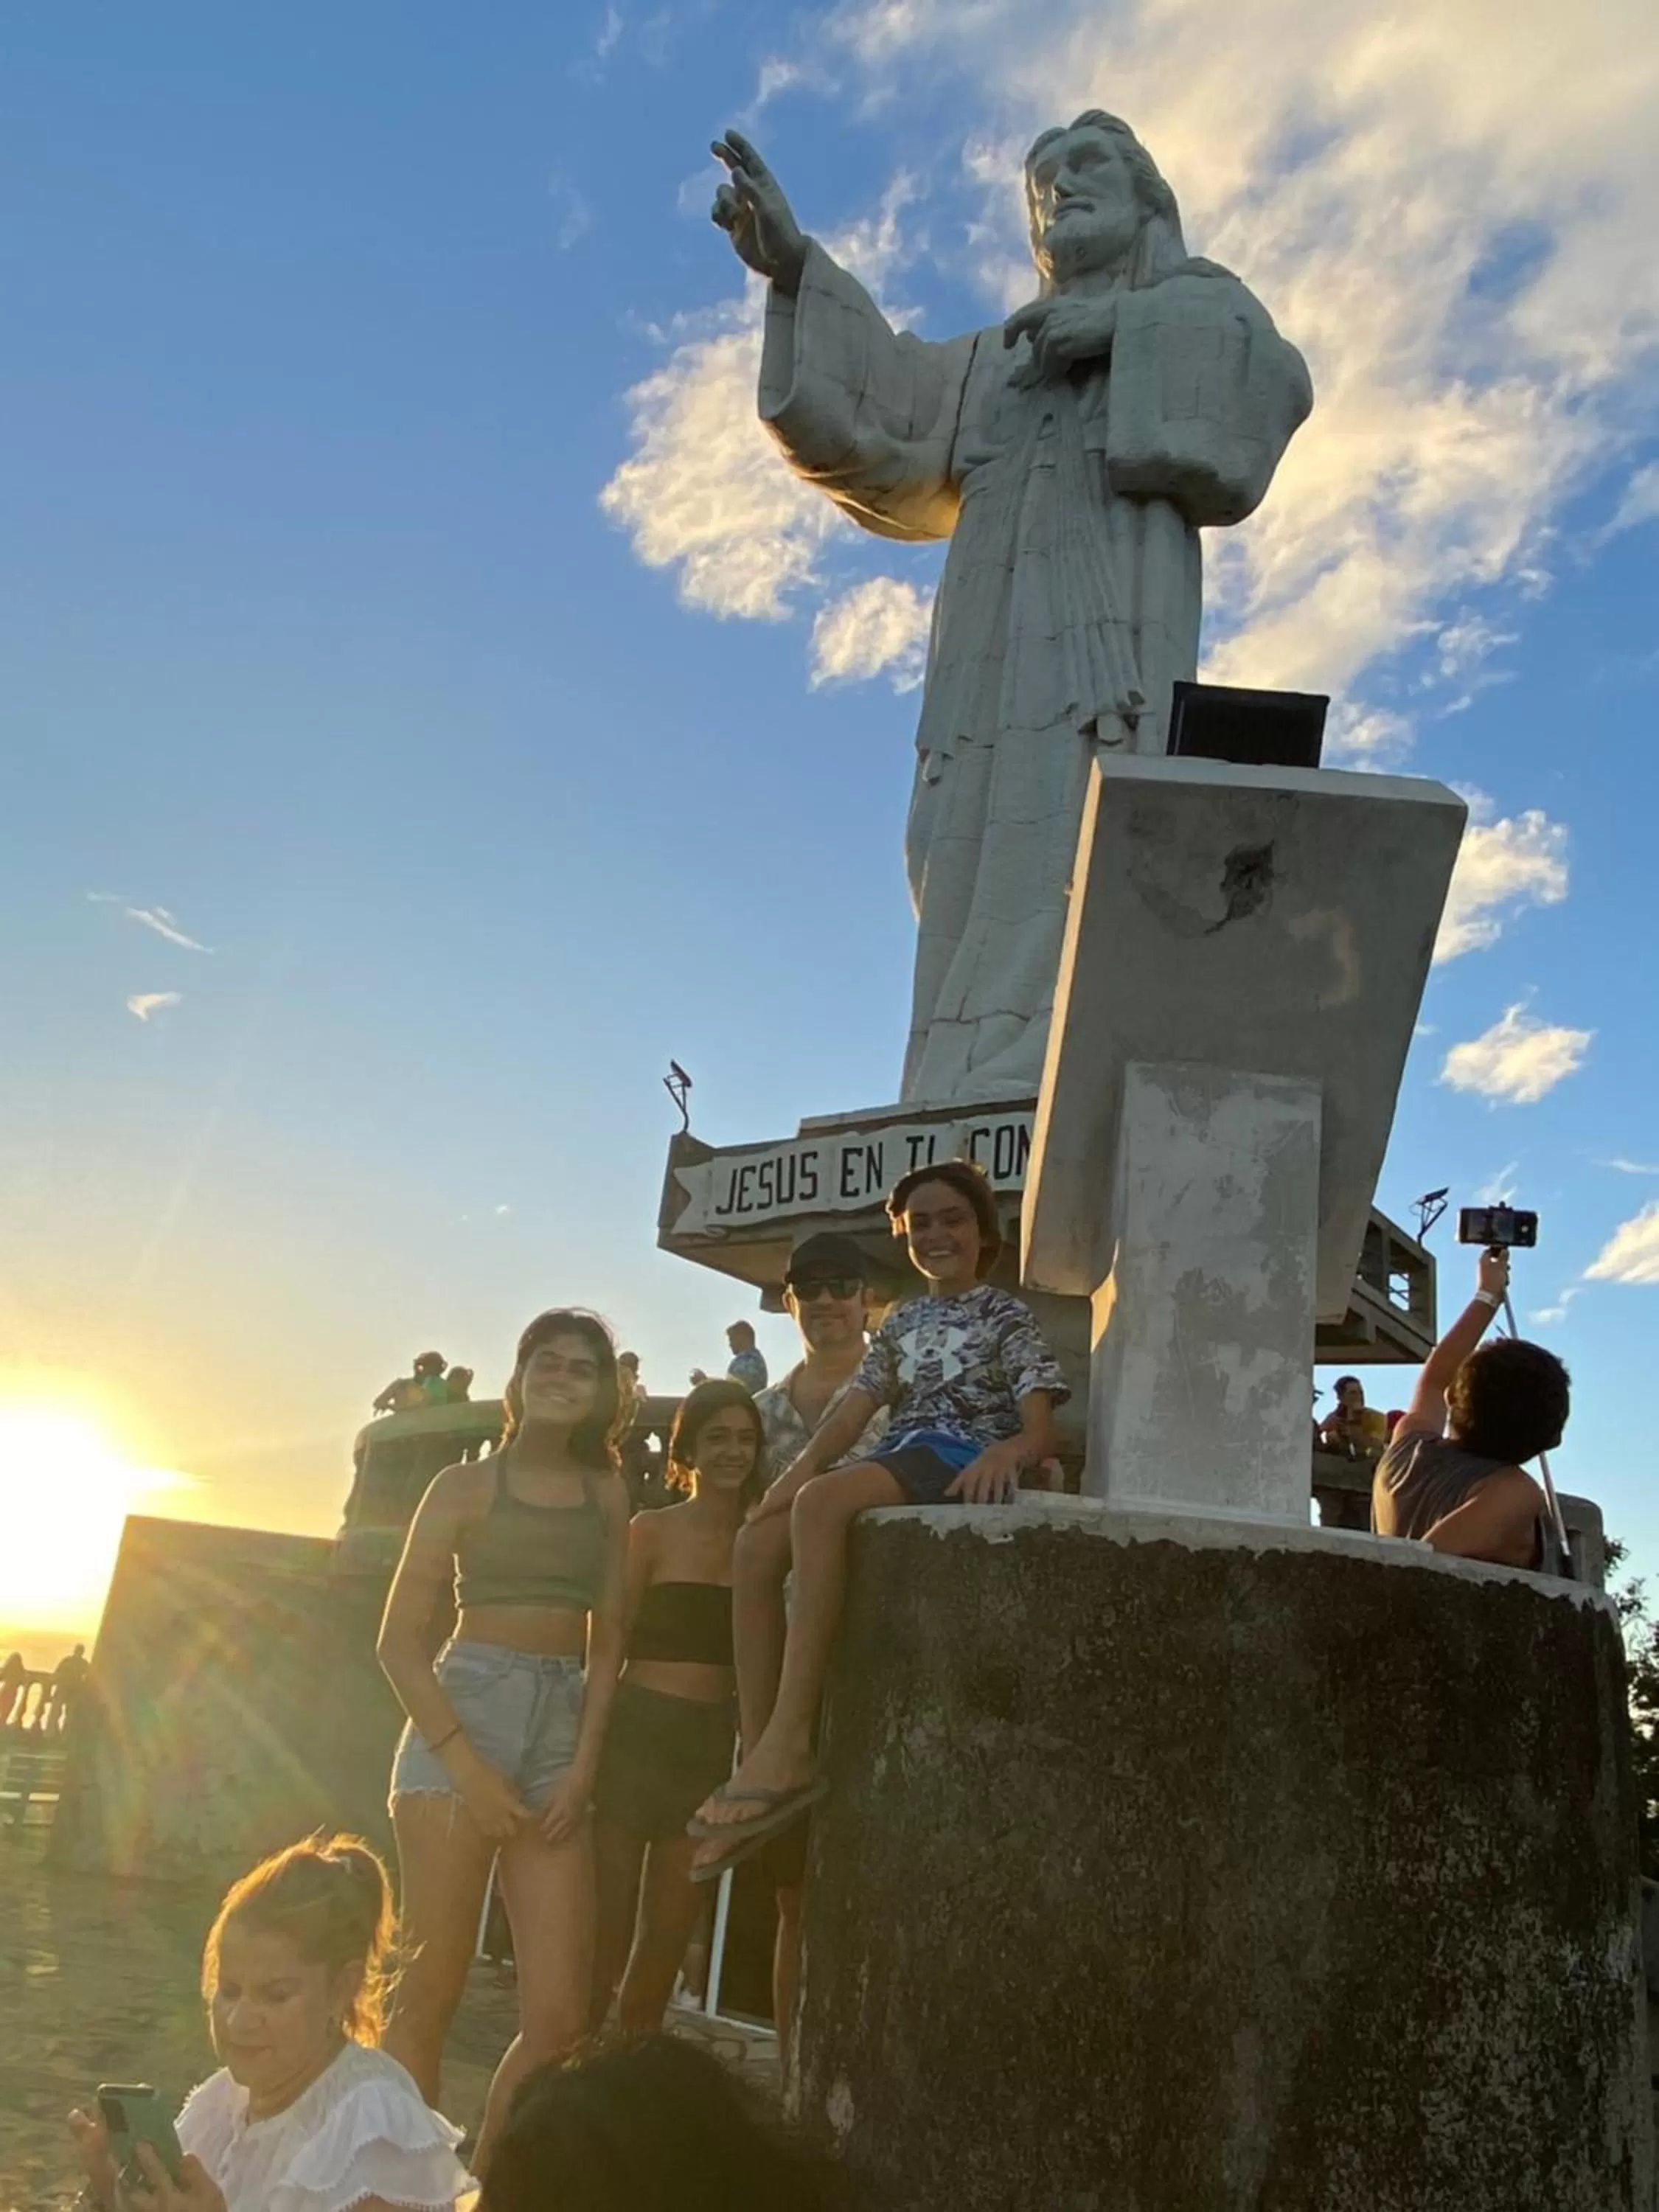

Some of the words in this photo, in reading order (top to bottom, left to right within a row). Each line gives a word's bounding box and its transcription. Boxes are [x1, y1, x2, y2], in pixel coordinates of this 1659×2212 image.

[715, 1151, 818, 1215] JESUS
[839, 1141, 883, 1198] EN
[905, 1134, 936, 1171] TI
